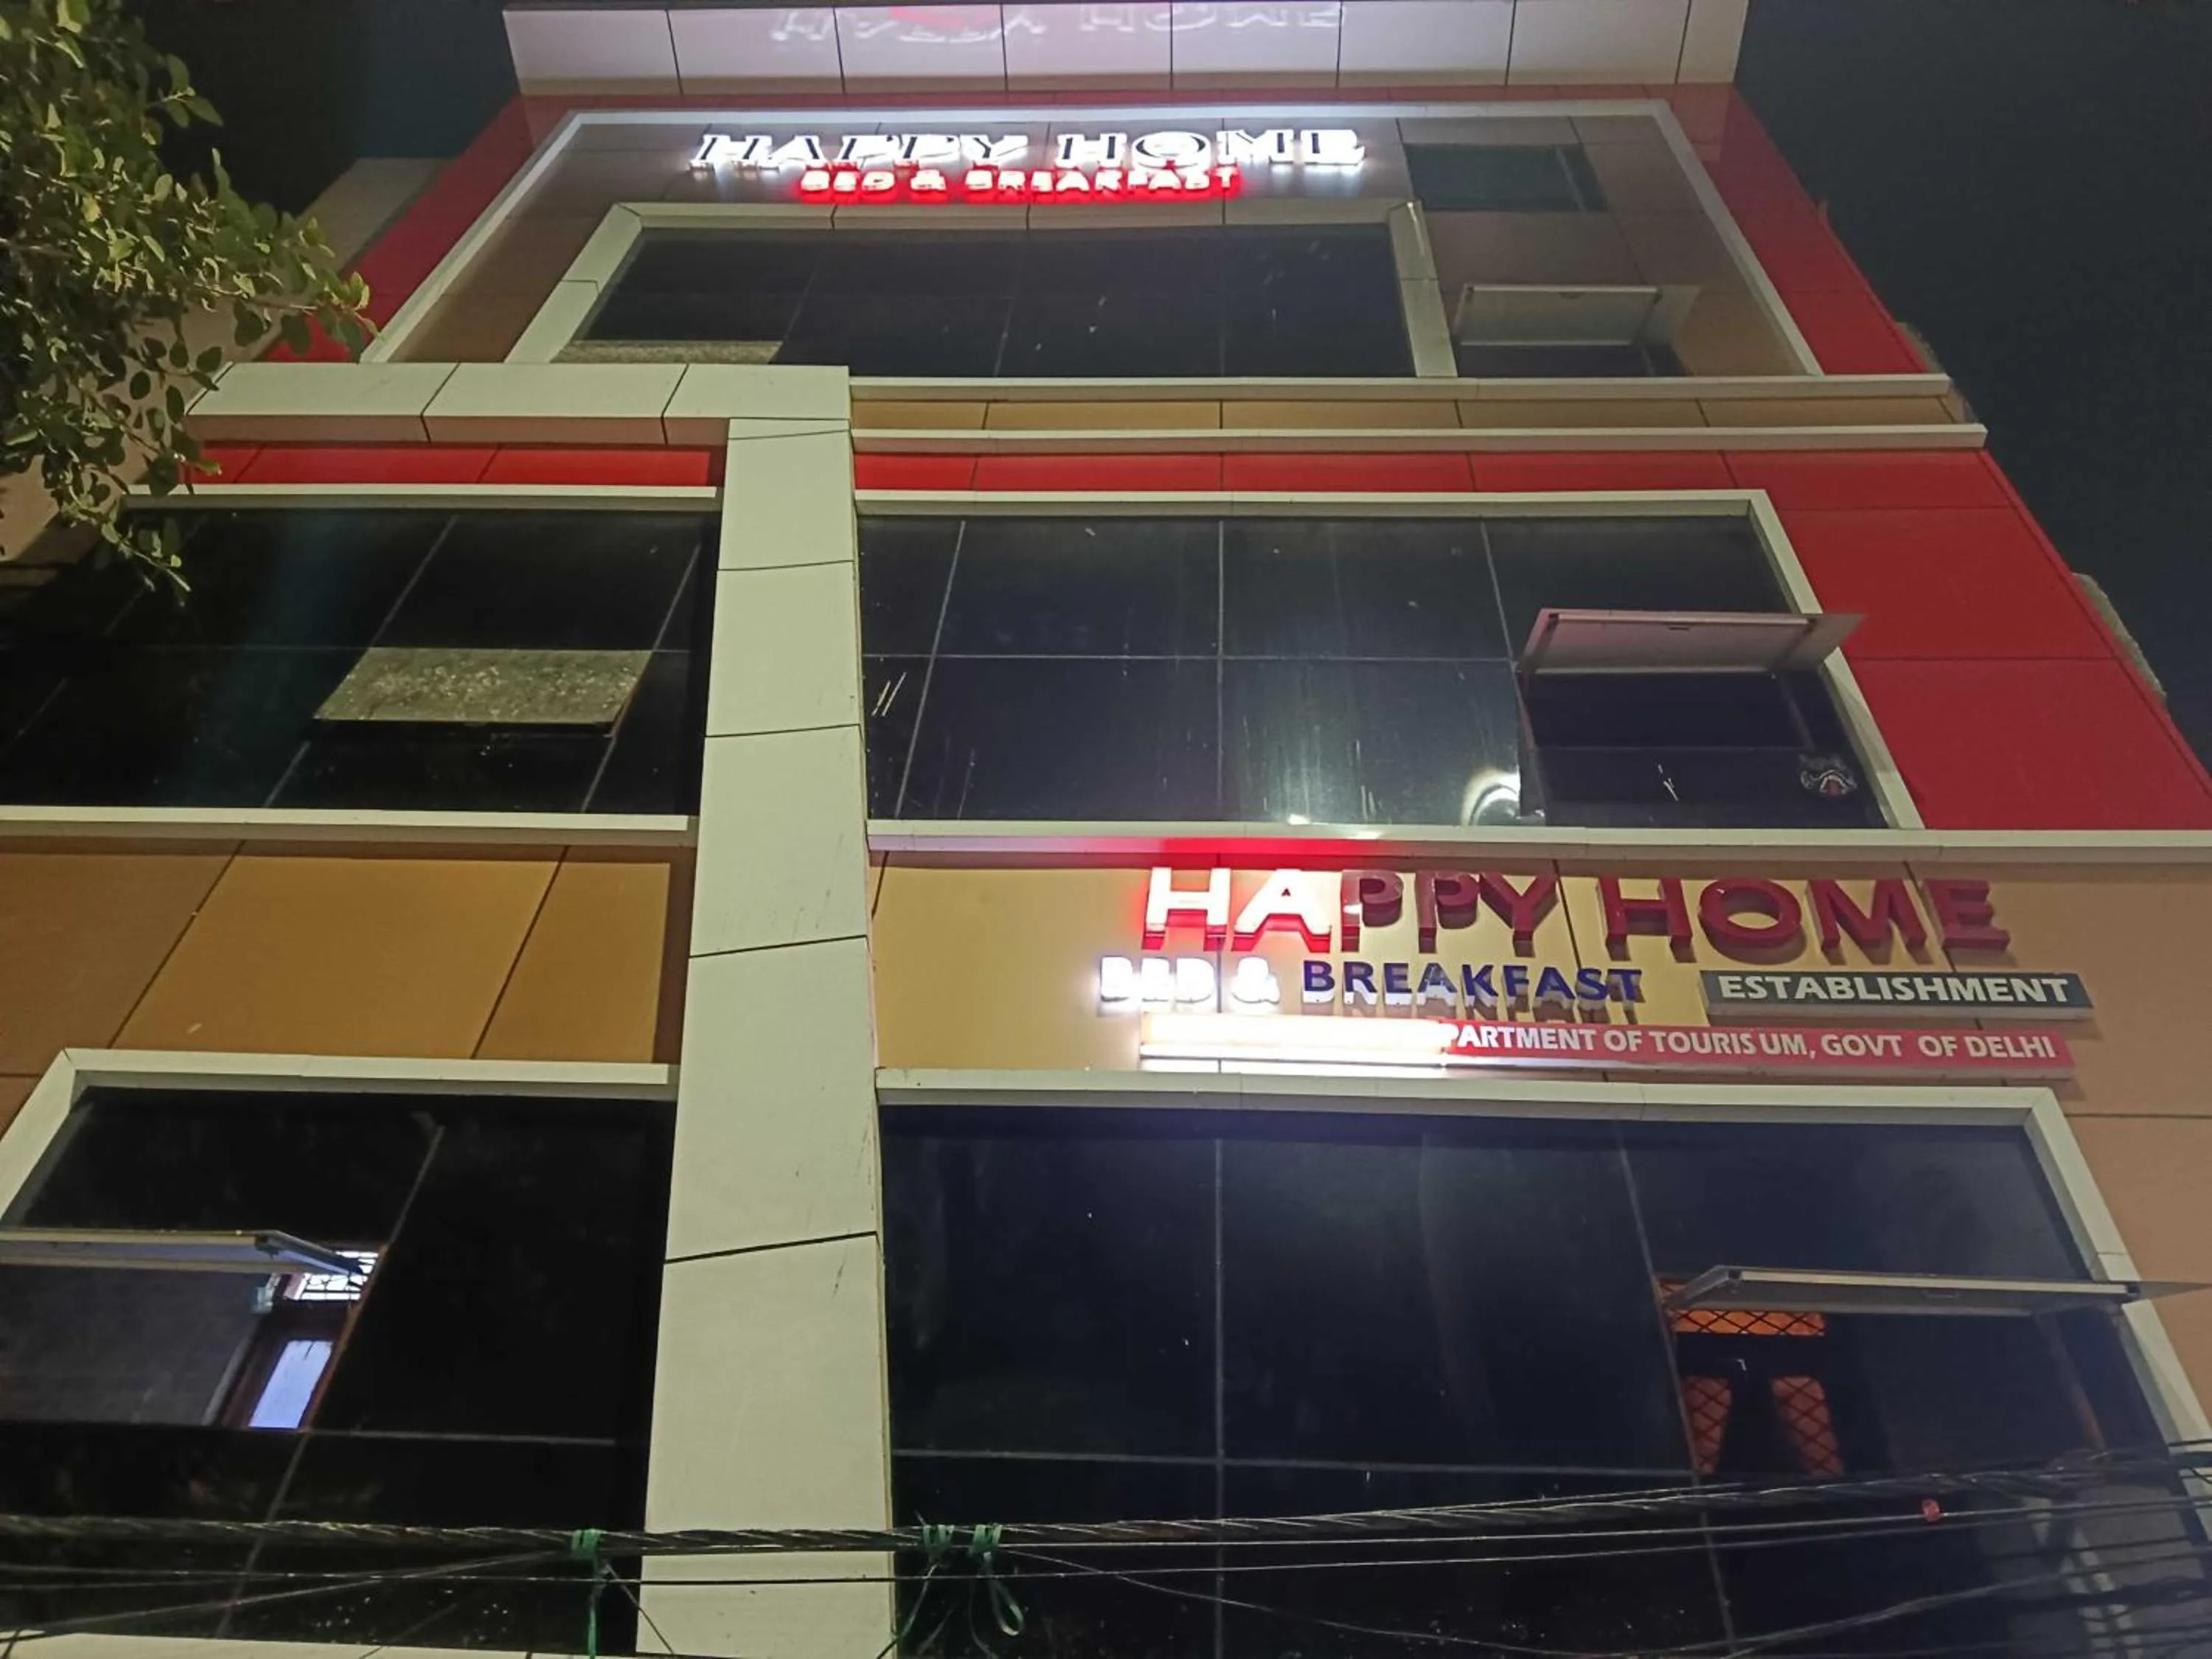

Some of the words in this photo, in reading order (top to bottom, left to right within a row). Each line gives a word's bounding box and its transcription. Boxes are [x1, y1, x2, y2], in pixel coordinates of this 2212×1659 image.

[690, 135, 1029, 170] HAPPY
[1055, 129, 1365, 167] HOME
[965, 167, 1240, 193] BREAKFAST
[1142, 867, 1559, 944] HAPPY
[1597, 874, 2011, 951] HOME
[1231, 956, 1281, 1004] &
[1302, 960, 1644, 1010] BREAKFAST
[1718, 975, 2069, 1003] ESTABLISHMENT
[1438, 1023, 1596, 1051] PARTMENT
[1604, 1029, 1644, 1053] OF
[1820, 1034, 1902, 1057] GOVT
[1917, 1035, 1958, 1057] OF
[1964, 1035, 2057, 1060] DELHI
